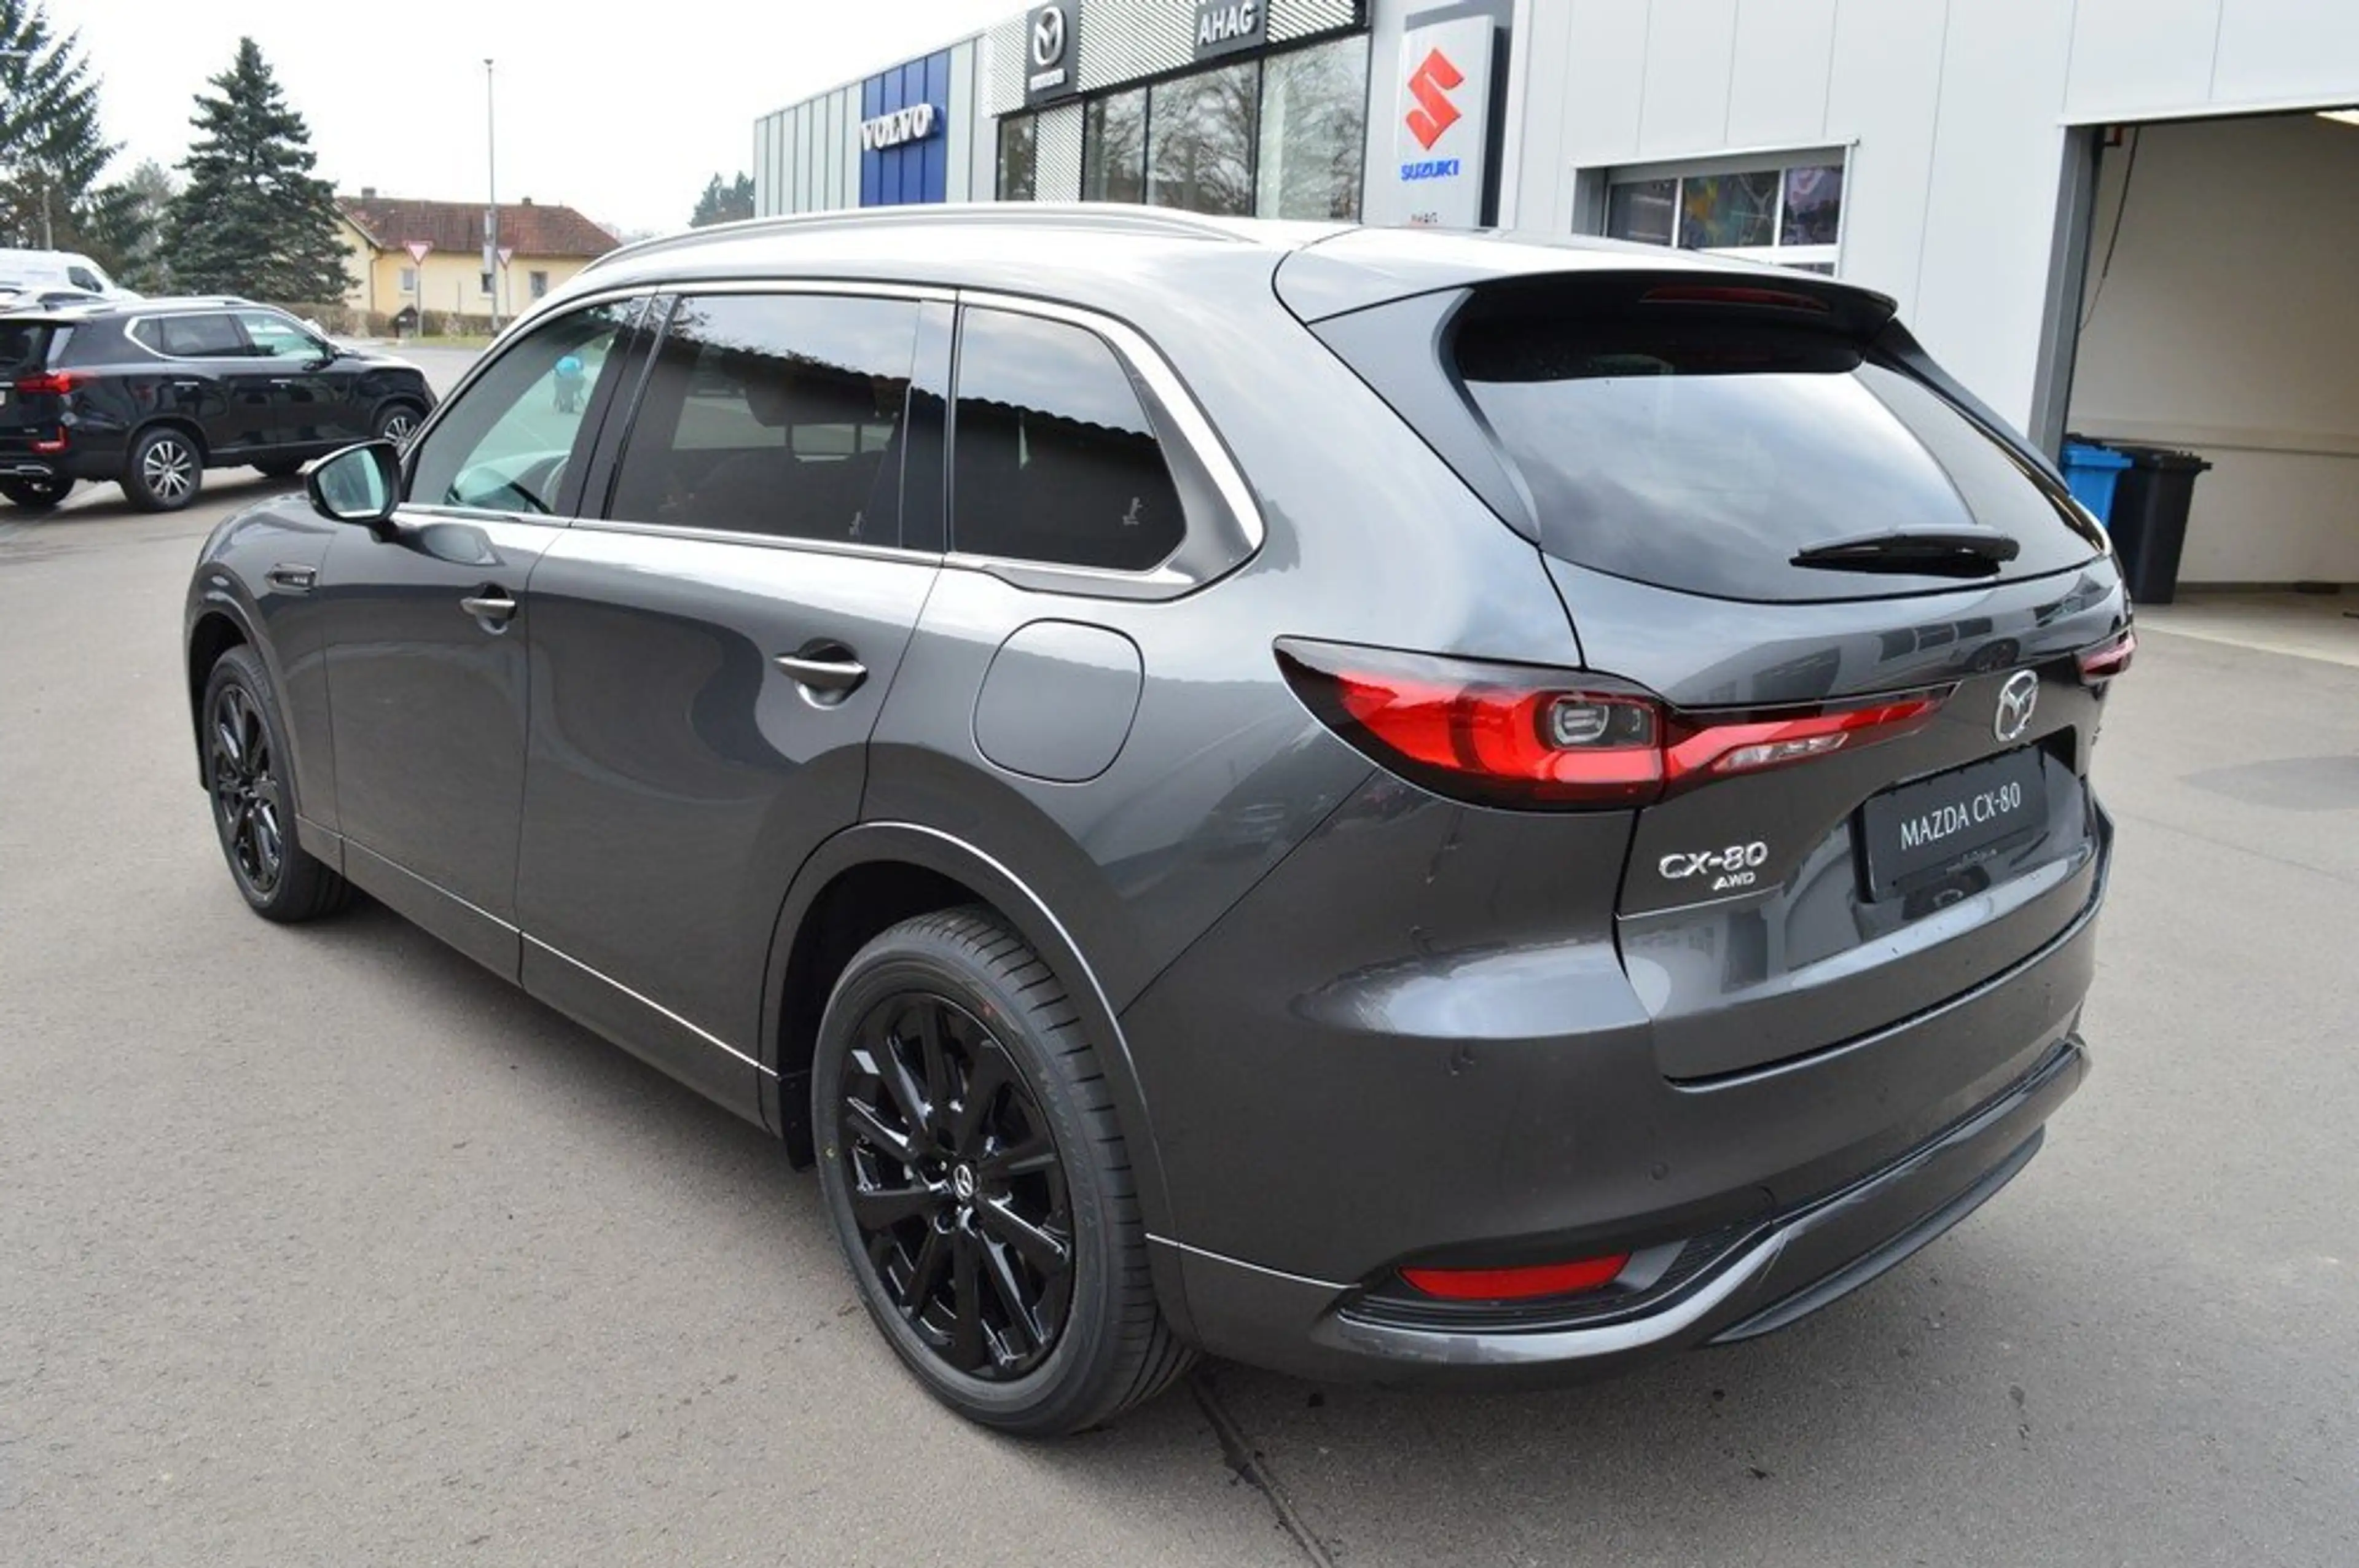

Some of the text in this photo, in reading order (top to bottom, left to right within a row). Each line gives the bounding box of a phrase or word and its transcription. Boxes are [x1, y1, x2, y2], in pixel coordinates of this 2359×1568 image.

[1198, 2, 1254, 45] AHAG
[860, 103, 933, 151] VOLVO
[1401, 159, 1460, 181] SUZUKI
[1901, 781, 2021, 851] MAZDA CX-80
[1659, 841, 1768, 879] CX-80
[1712, 872, 1756, 891] AWD
